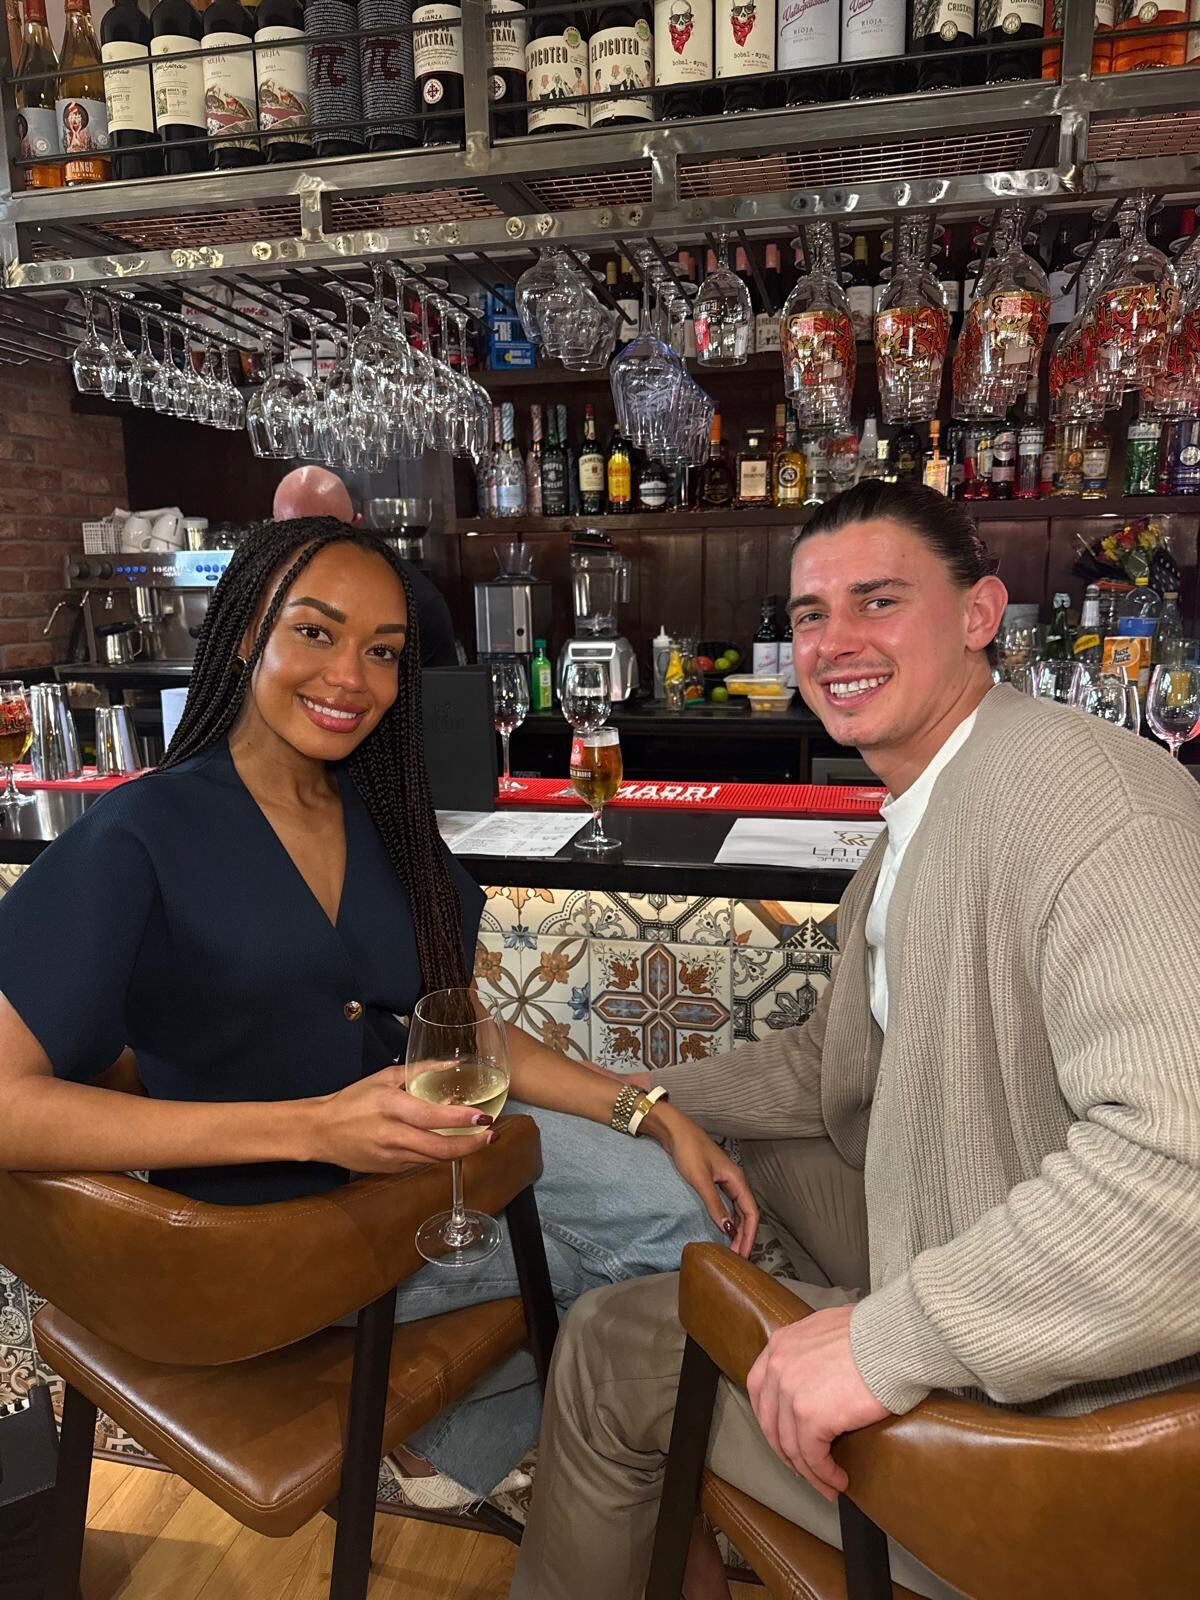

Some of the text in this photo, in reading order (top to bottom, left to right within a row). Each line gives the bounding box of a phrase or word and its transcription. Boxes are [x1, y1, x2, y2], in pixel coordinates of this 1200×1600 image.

[793, 27, 815, 35] RIOJA
[599, 38, 639, 58] PICOTEO
[531, 46, 568, 69] PICOTEO
[1018, 435, 1044, 444] CAMPA
